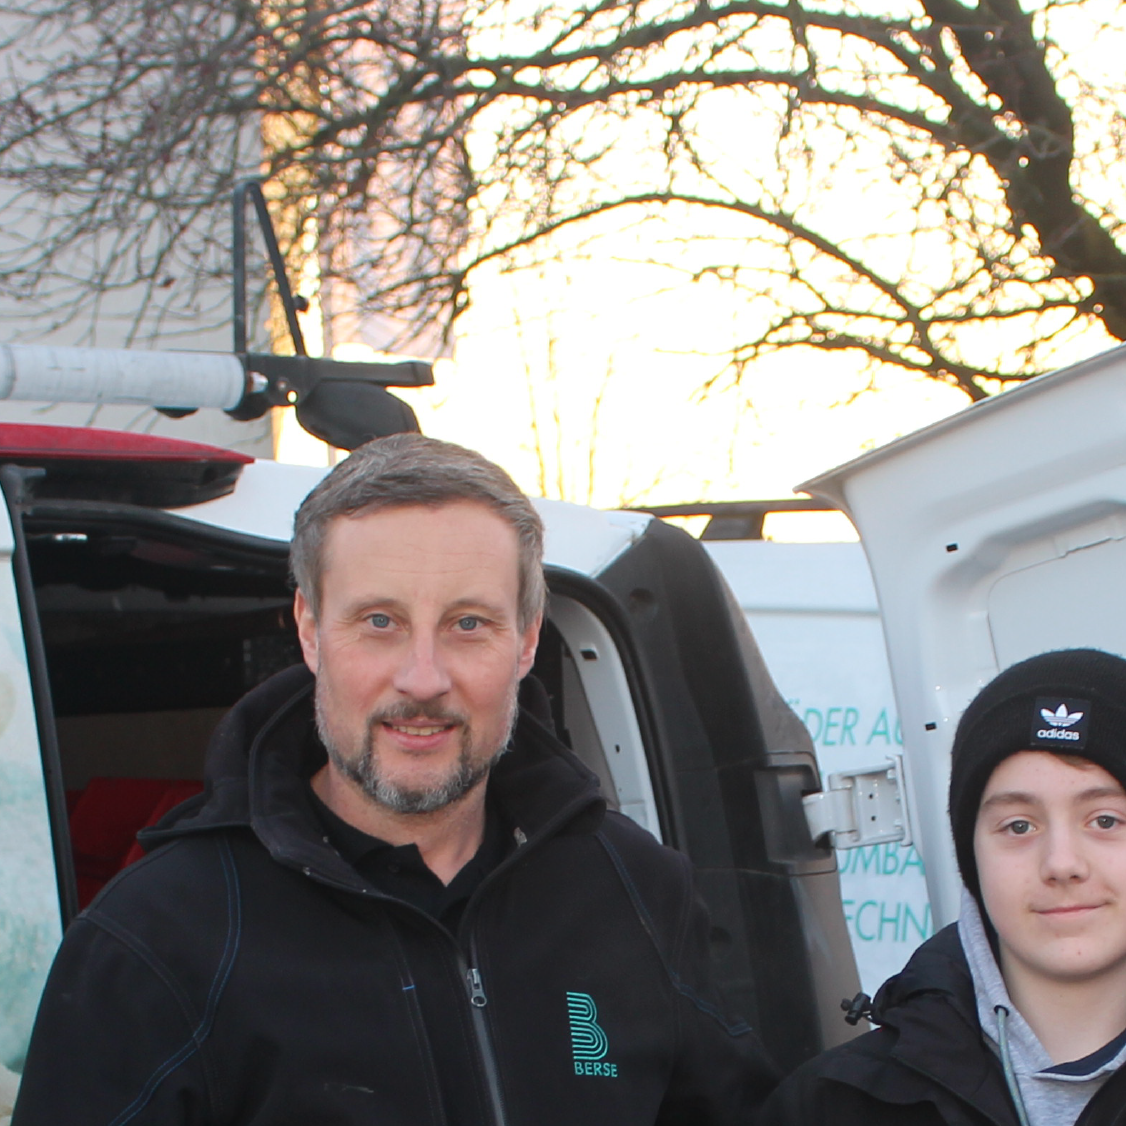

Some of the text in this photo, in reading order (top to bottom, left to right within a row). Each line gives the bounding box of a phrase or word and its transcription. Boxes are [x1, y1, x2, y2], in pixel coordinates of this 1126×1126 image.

[789, 699, 859, 746] DER
[1037, 728, 1080, 741] adidas
[574, 1061, 618, 1078] BERSE
